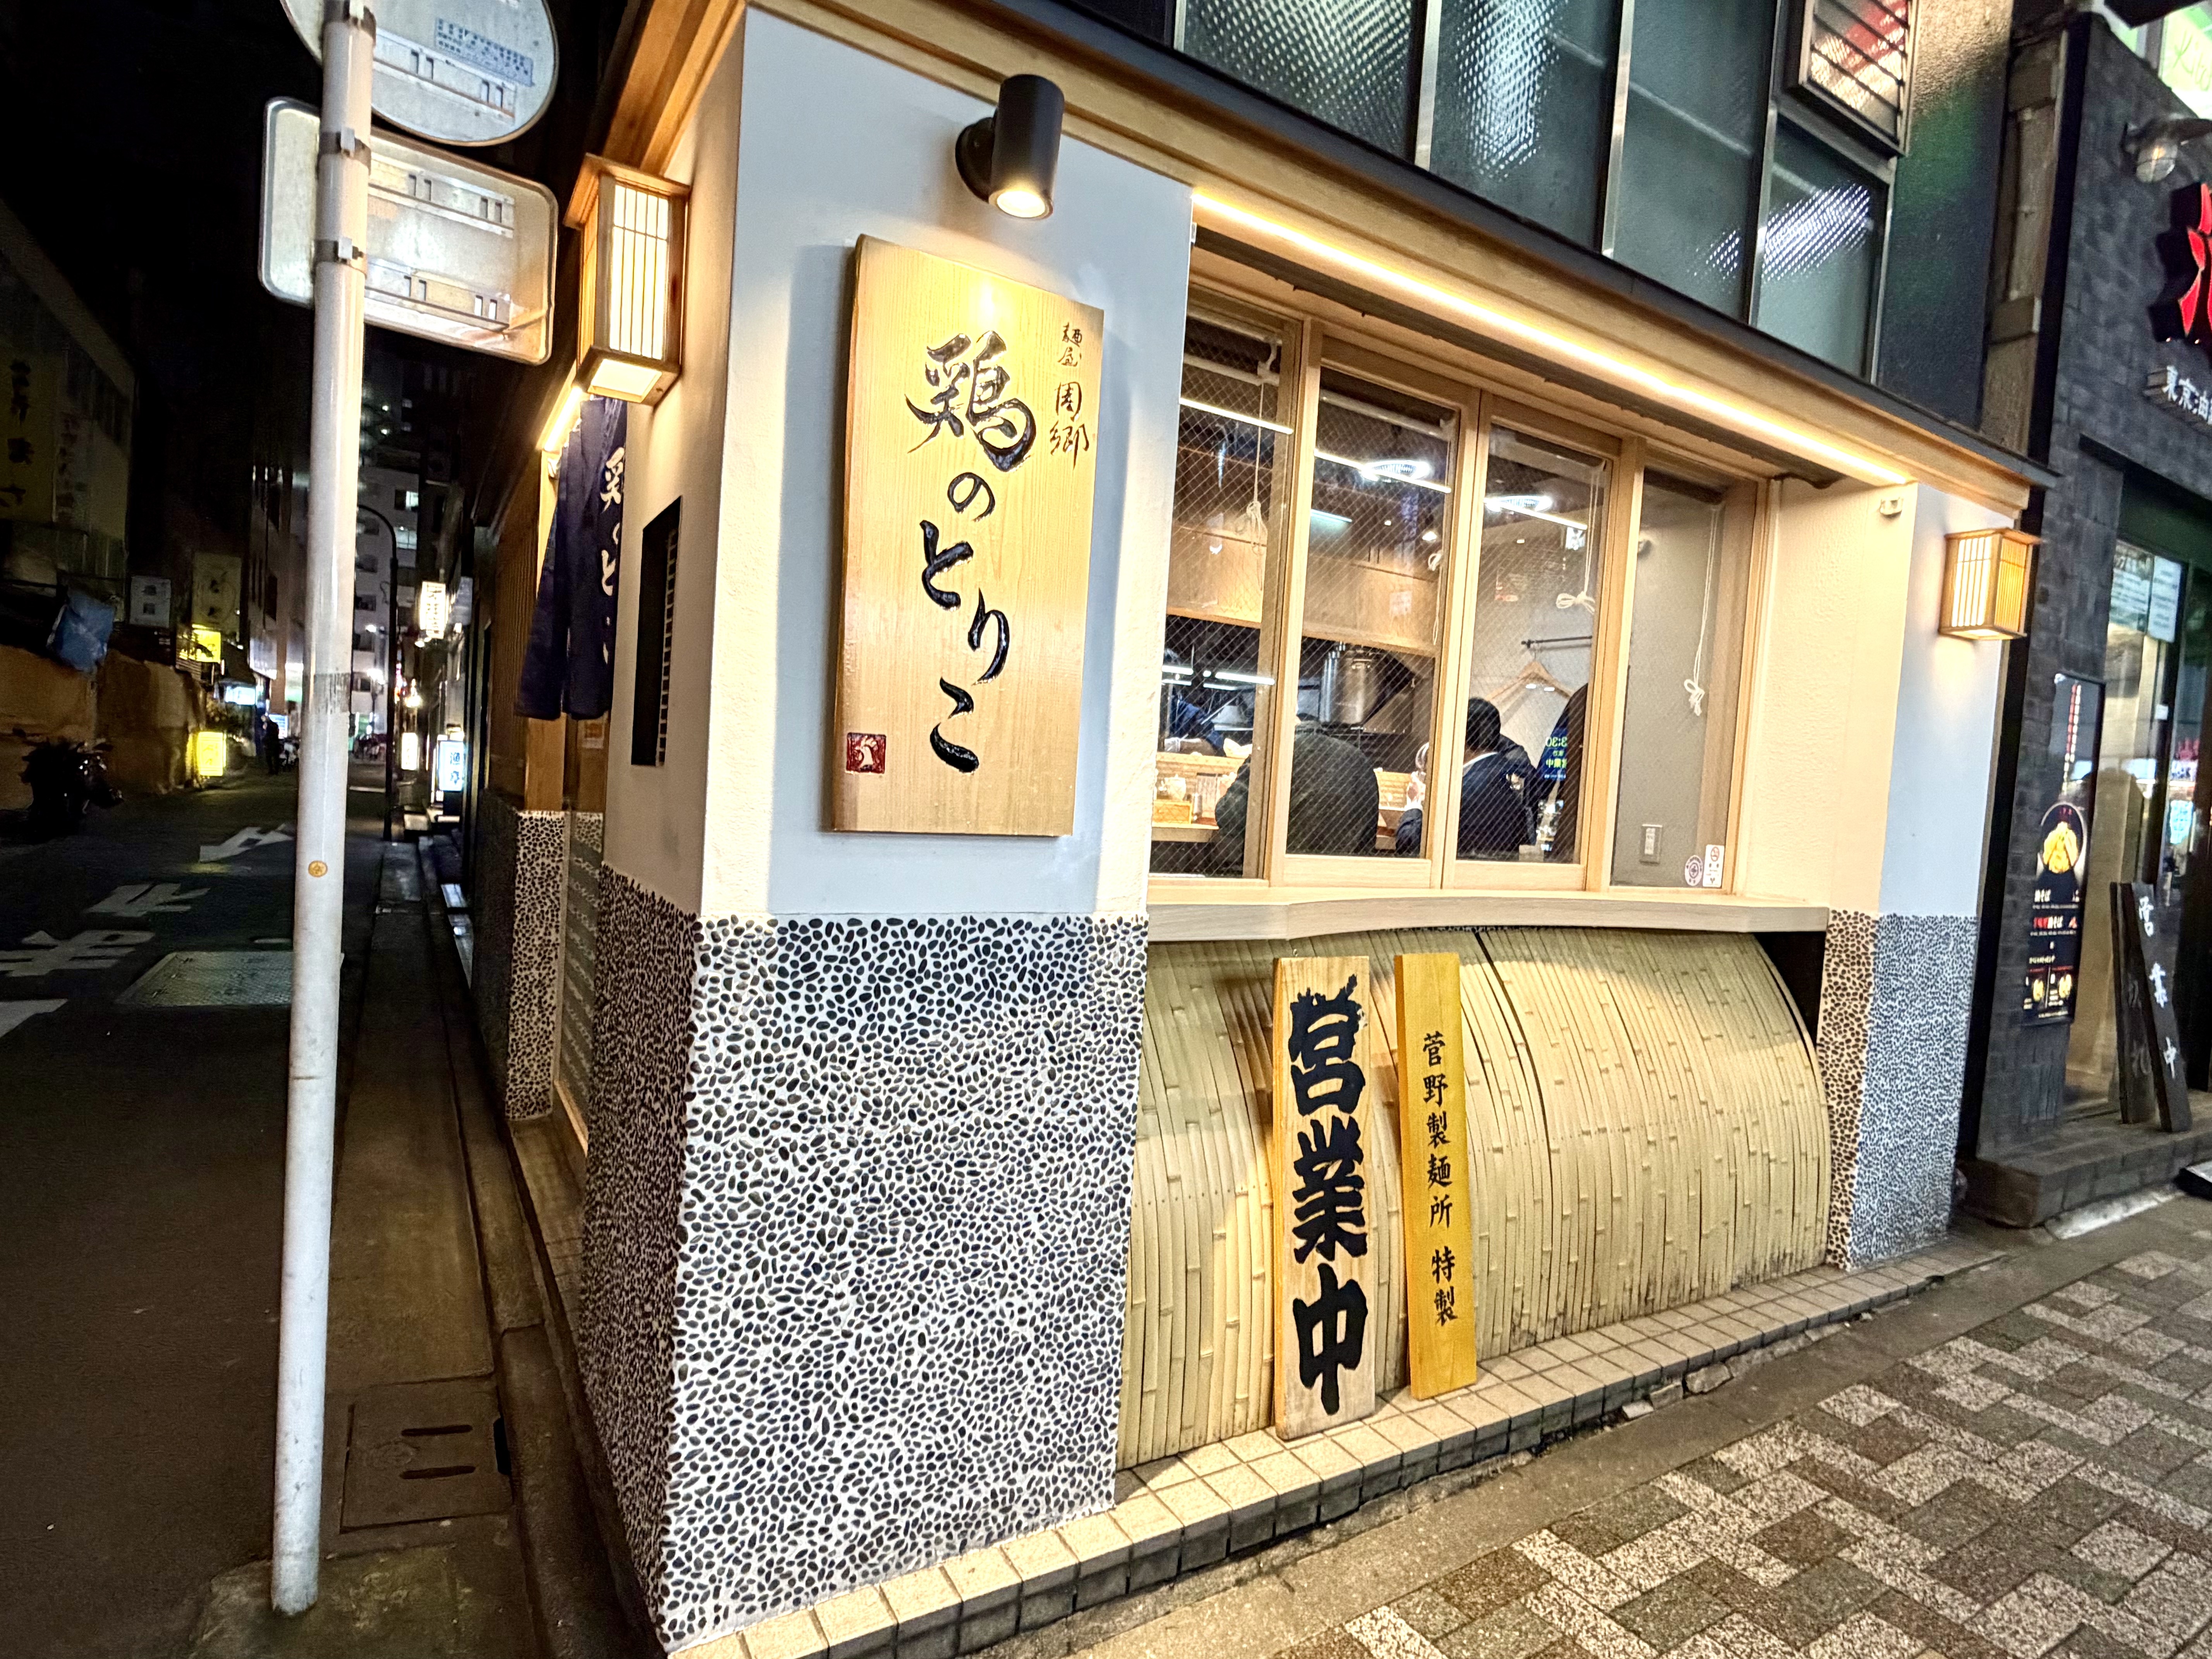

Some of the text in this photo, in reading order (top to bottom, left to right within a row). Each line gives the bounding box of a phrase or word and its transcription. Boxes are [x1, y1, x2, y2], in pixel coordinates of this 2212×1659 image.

[1058, 322, 1082, 367] 麺屋
[904, 330, 1038, 774] 鶏のとりこ
[1288, 973, 1367, 1416] 営業中
[1422, 1032, 1459, 1328] 菅野製麺所 特製
